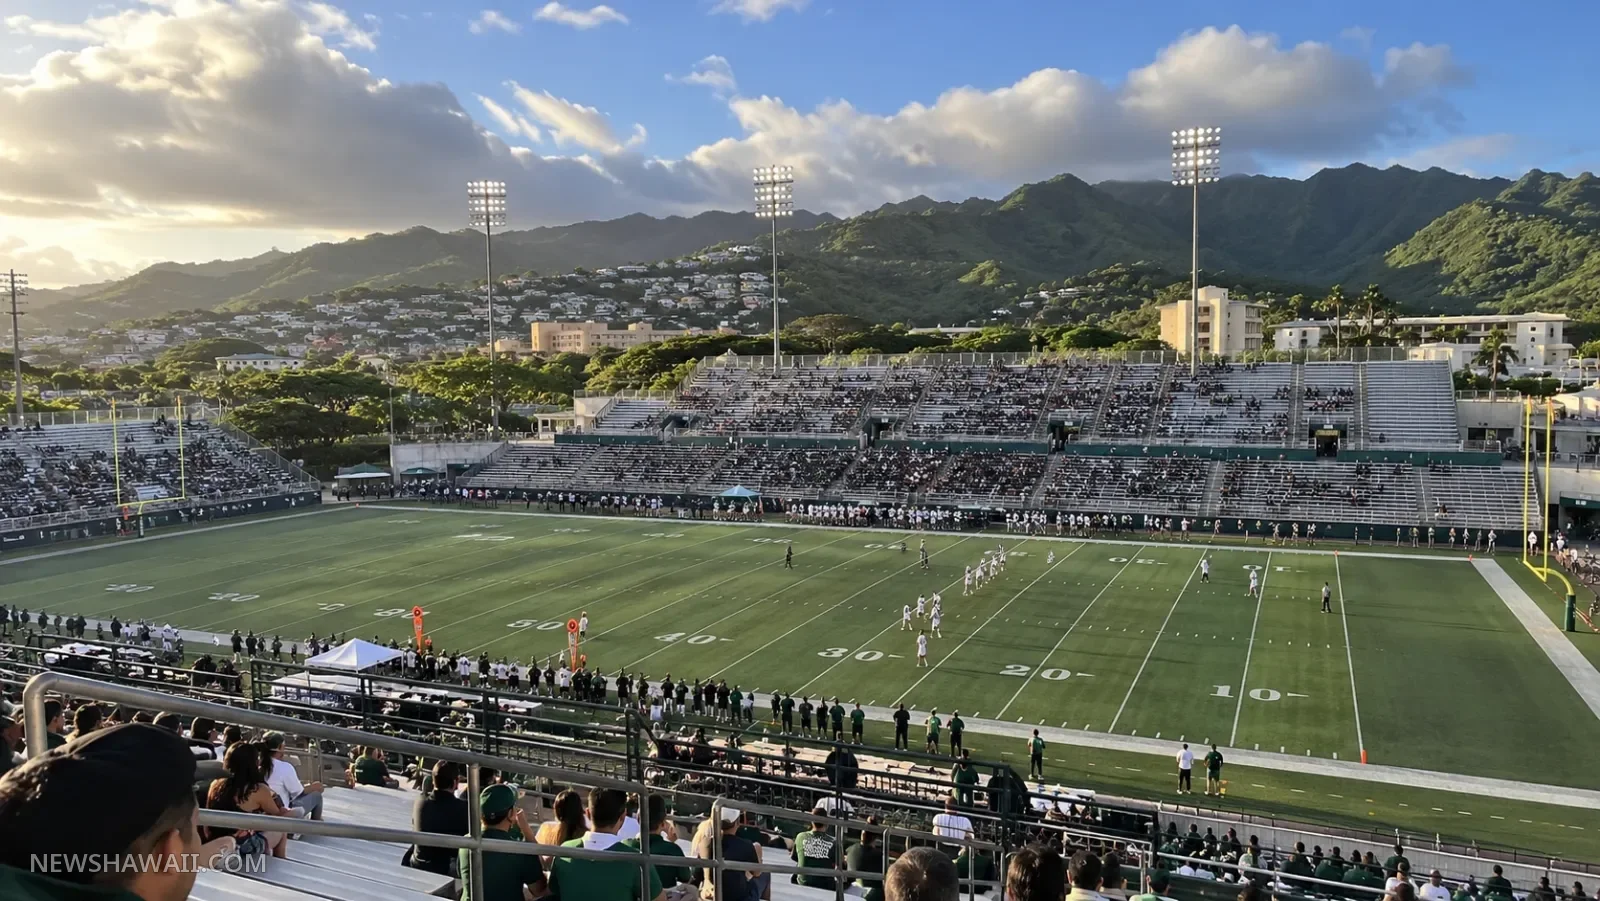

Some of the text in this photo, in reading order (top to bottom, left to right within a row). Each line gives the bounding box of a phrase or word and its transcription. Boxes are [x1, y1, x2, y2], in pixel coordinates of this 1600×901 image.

[506, 618, 564, 631] 50
[653, 631, 717, 645] 40
[817, 647, 884, 661] 30
[999, 664, 1071, 681] 20
[1210, 685, 1281, 702] 10
